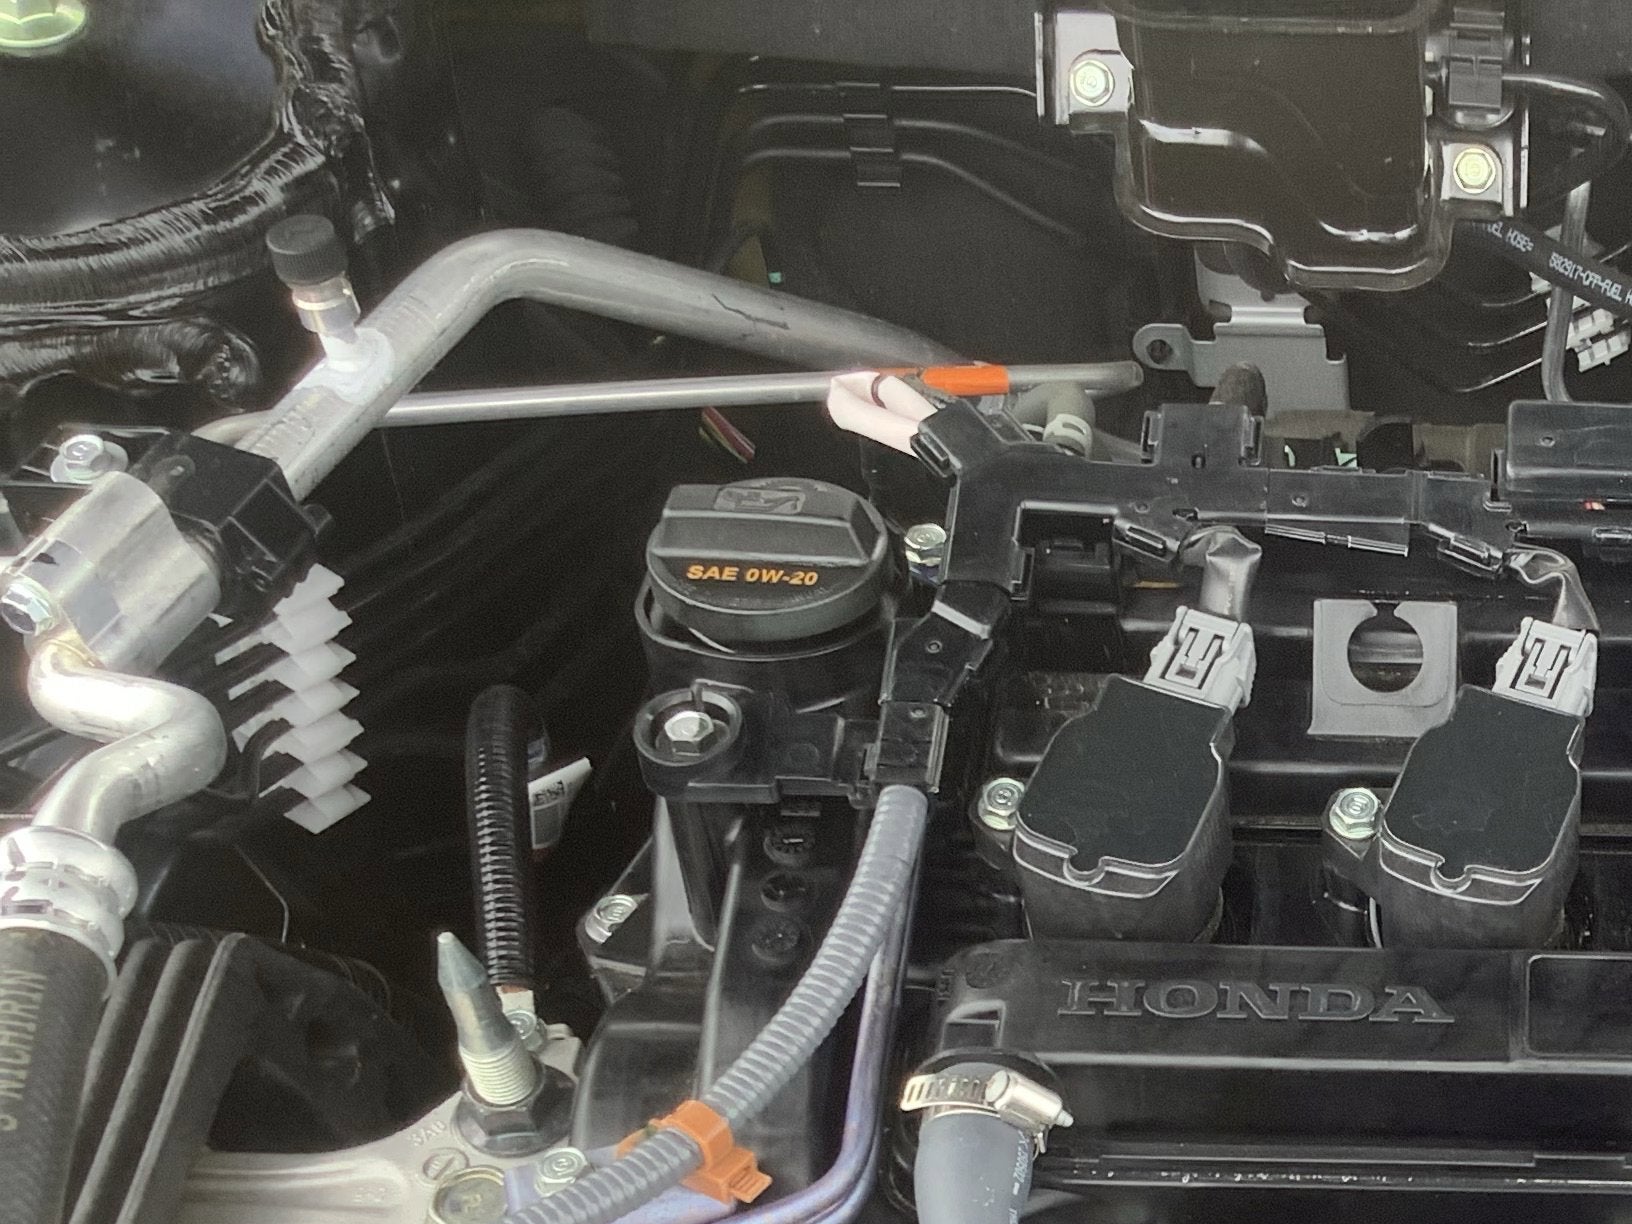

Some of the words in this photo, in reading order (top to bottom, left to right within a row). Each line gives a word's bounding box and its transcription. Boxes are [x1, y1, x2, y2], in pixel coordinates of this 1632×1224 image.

[686, 565, 740, 582] SAE
[745, 568, 819, 586] 0W-20
[1057, 978, 1456, 1024] HONDA
